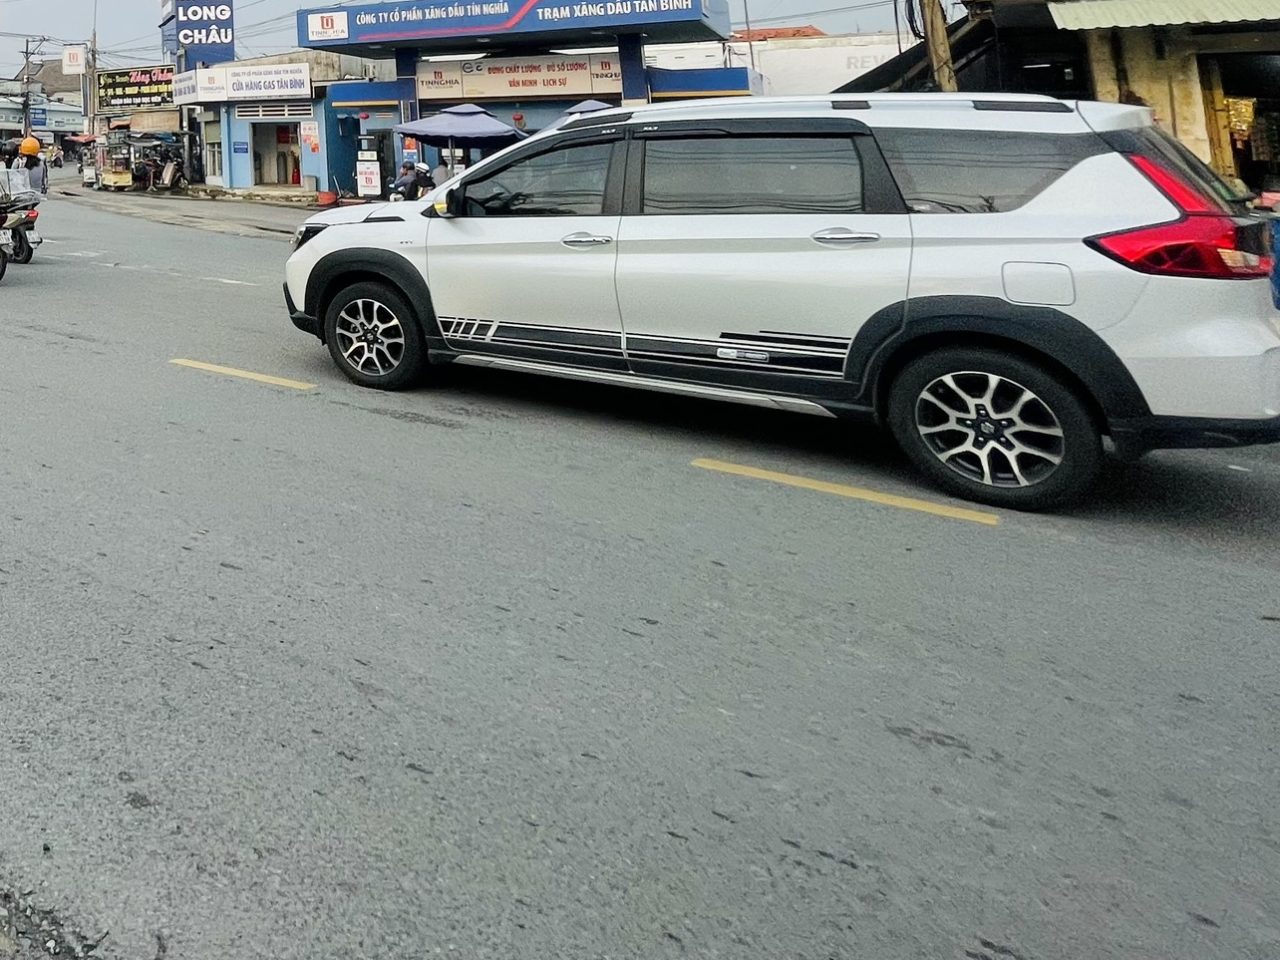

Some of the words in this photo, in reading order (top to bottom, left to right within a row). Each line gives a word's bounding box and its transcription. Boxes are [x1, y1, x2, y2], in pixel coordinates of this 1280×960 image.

[178, 5, 231, 20] LONG
[356, 12, 375, 25] CÔNG
[379, 13, 389, 23] TY
[390, 7, 400, 22] CỔ
[402, 6, 423, 21] PHẦN
[425, 6, 446, 20] XĂNG
[448, 2, 465, 17] DẦU
[467, 2, 481, 16] TÍN
[482, 0, 509, 14] NGHĨA
[536, 7, 571, 21] TRẠM
[573, 2, 605, 17] XĂNG
[178, 24, 233, 44] CHÂU
[521, 64, 542, 74] LƯỢNG
[557, 62, 566, 72] SỐ
[232, 79, 244, 91] CỬA
[245, 80, 262, 90] HÀNG
[263, 80, 275, 90] GAS
[277, 78, 288, 89] TÂN
[289, 77, 305, 88] BÌNH
[542, 79, 556, 87] LỊCH
